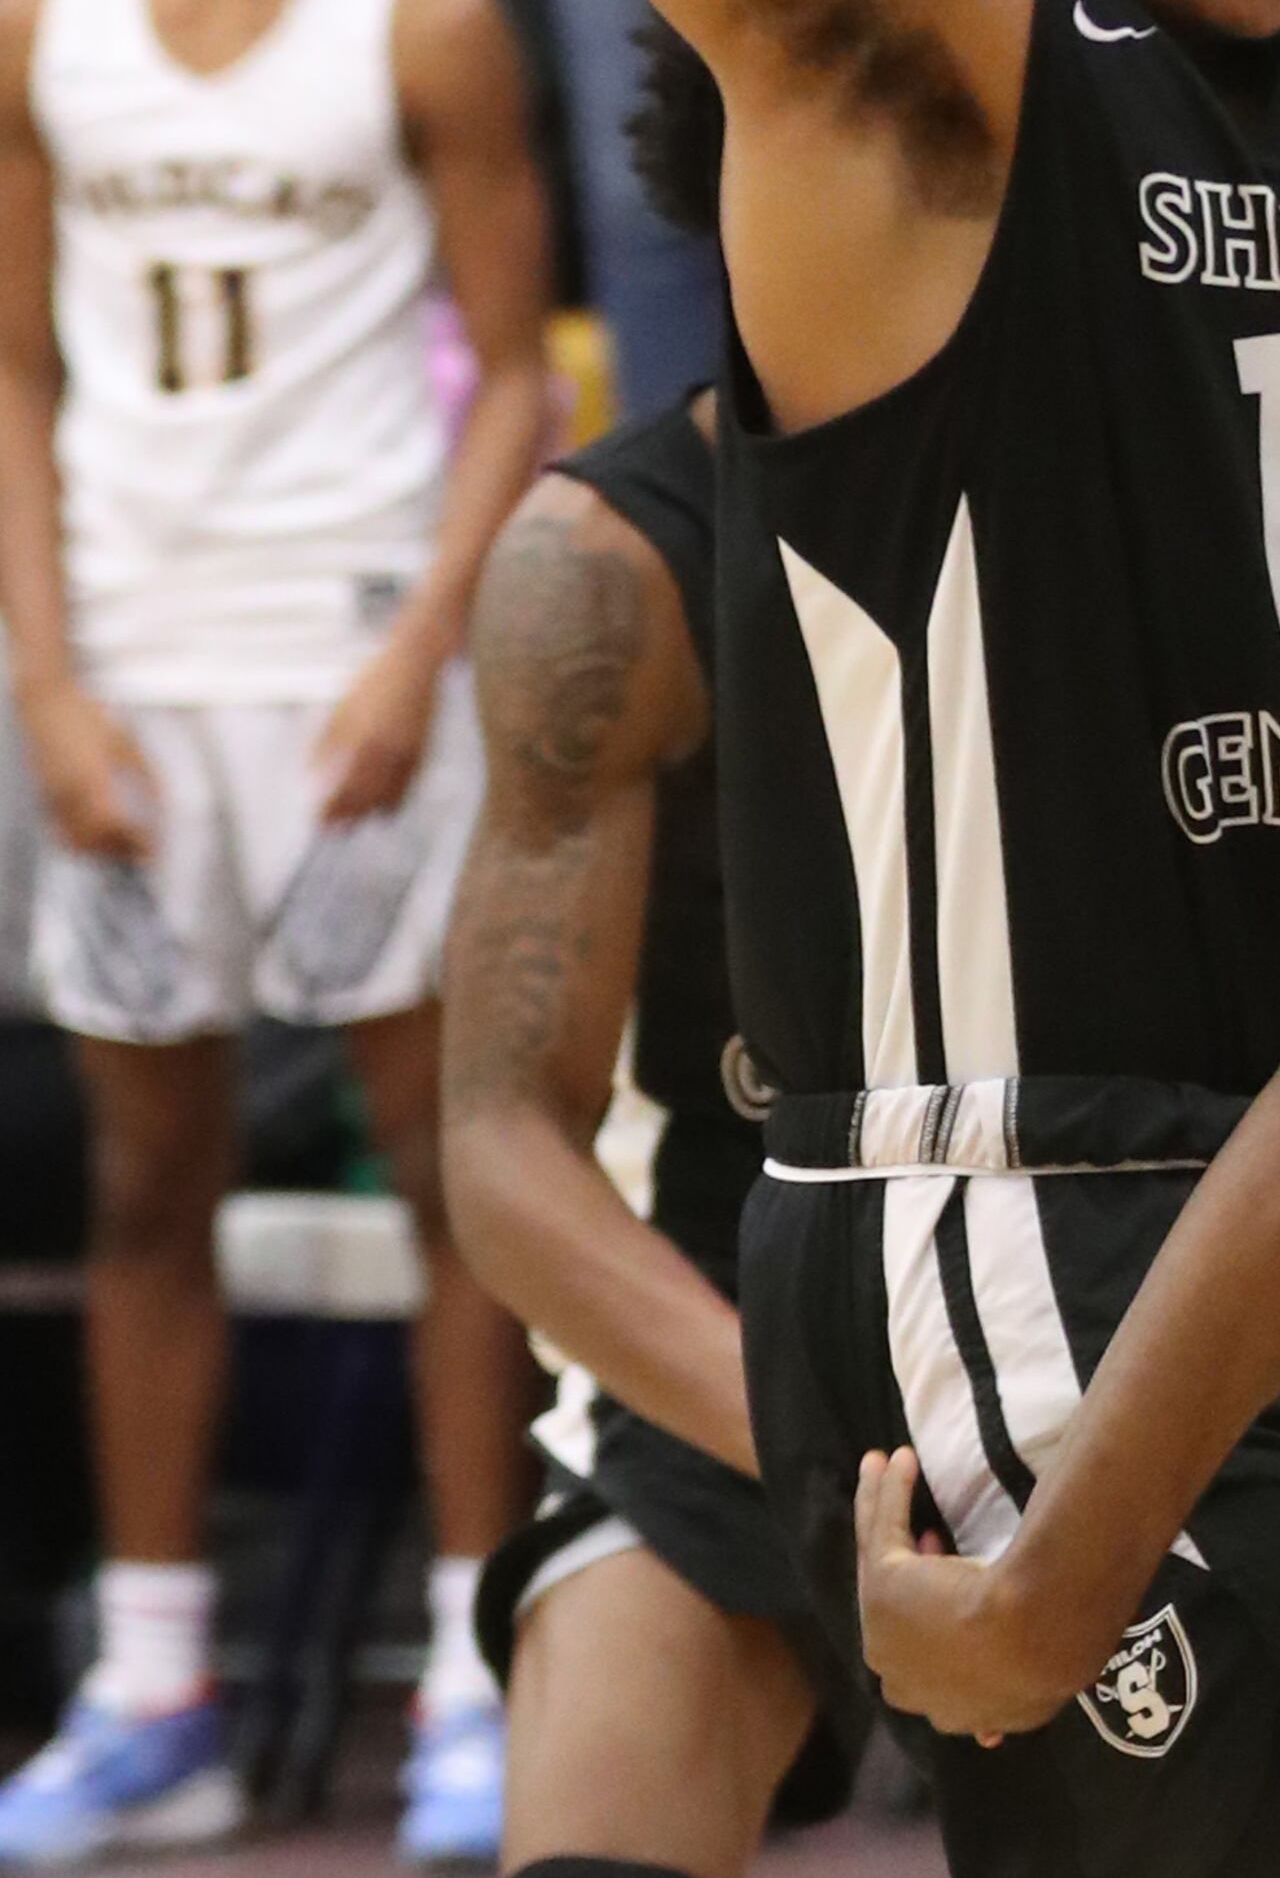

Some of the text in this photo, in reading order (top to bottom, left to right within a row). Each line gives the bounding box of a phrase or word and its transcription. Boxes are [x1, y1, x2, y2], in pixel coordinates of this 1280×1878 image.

[146, 259, 256, 393] 11
[1099, 1627, 1164, 1677] HILOH
[1116, 1660, 1172, 1740] S
